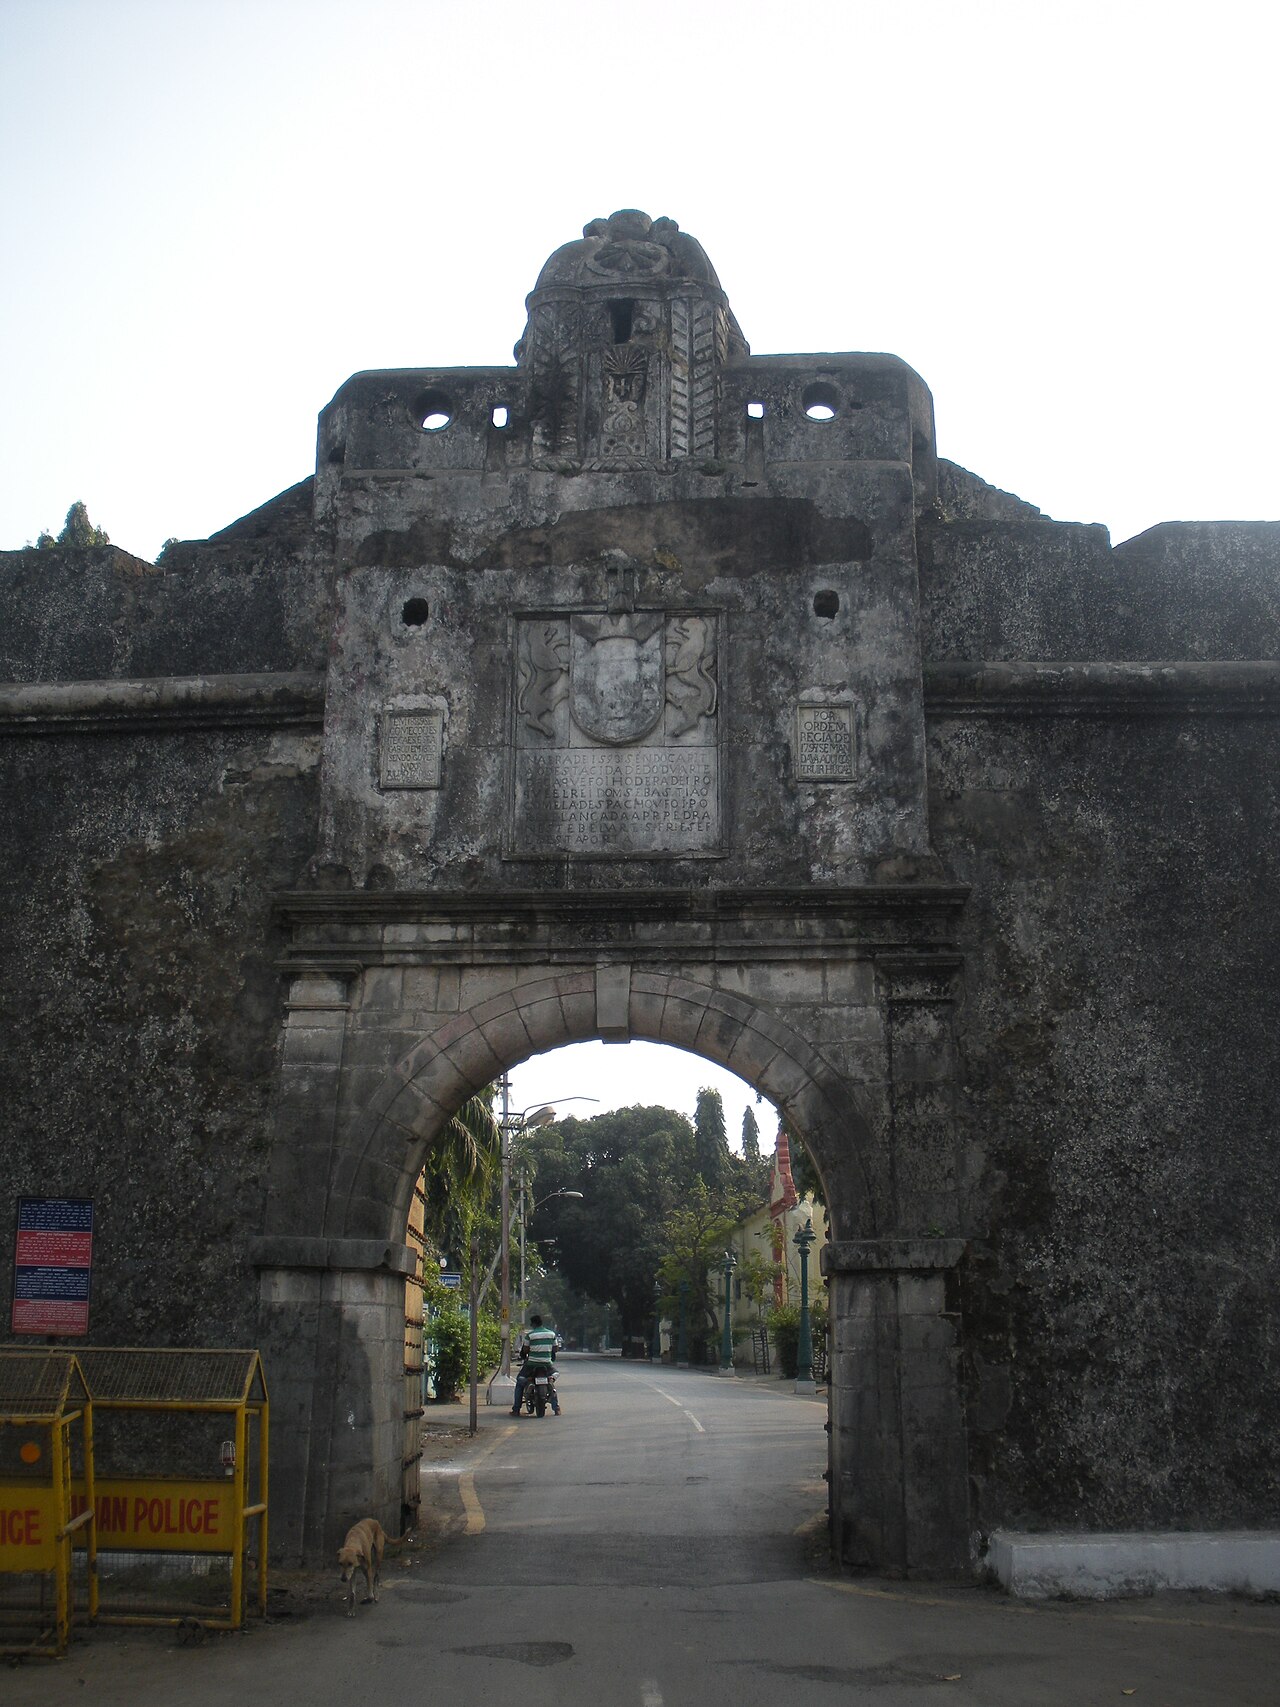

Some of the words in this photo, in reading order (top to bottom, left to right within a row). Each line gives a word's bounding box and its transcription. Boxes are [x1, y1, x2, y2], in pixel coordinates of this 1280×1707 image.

[814, 711, 836, 721] POR
[804, 721, 846, 732] ORDEM
[134, 1498, 219, 1534] POLICE
